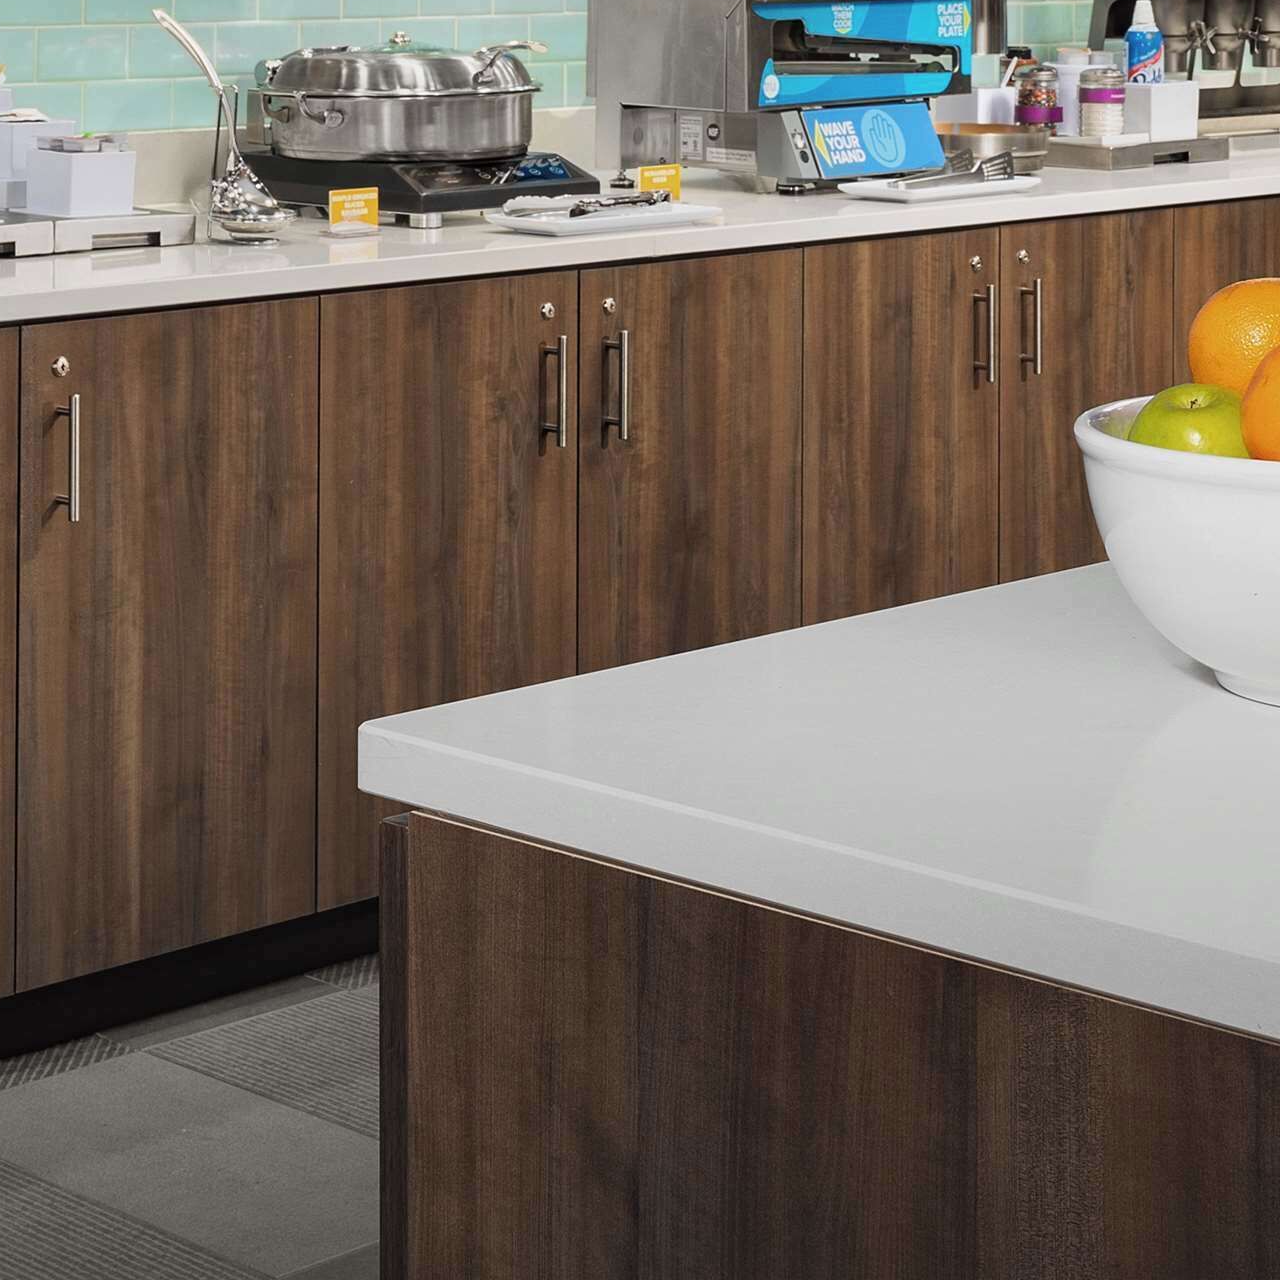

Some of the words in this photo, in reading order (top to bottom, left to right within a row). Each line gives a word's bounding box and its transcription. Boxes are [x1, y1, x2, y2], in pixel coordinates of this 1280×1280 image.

[937, 3, 963, 15] PLACE
[938, 14, 963, 26] YOUR
[938, 25, 964, 37] PLATE
[820, 120, 856, 136] WAVE
[825, 135, 861, 150] YOUR
[830, 148, 867, 165] HAND
